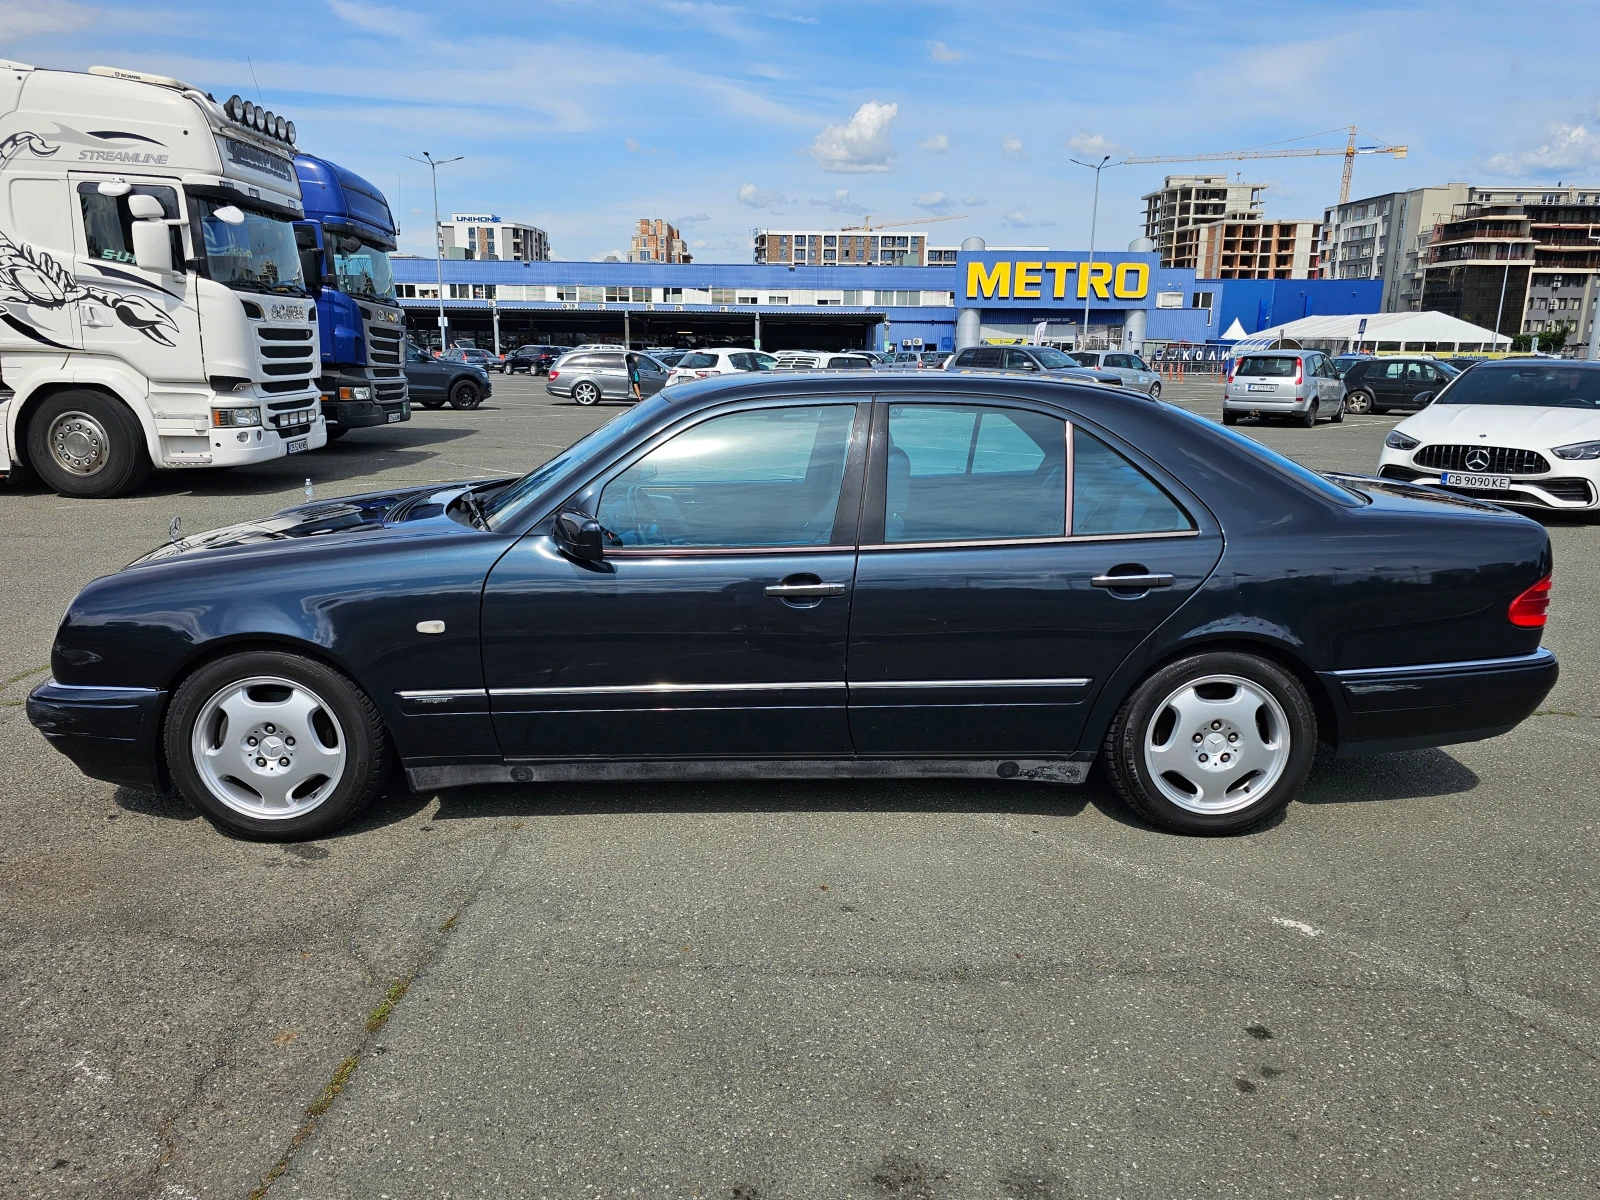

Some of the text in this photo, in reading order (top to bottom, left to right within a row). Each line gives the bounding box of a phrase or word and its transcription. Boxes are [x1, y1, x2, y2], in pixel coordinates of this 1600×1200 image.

[78, 149, 169, 165] STREAMLINE
[966, 261, 1150, 299] METRO
[1448, 474, 1507, 488] CB 9090 KE
[1285, 684, 1310, 730] DIPLOMAT
[1124, 727, 1135, 743] HP
